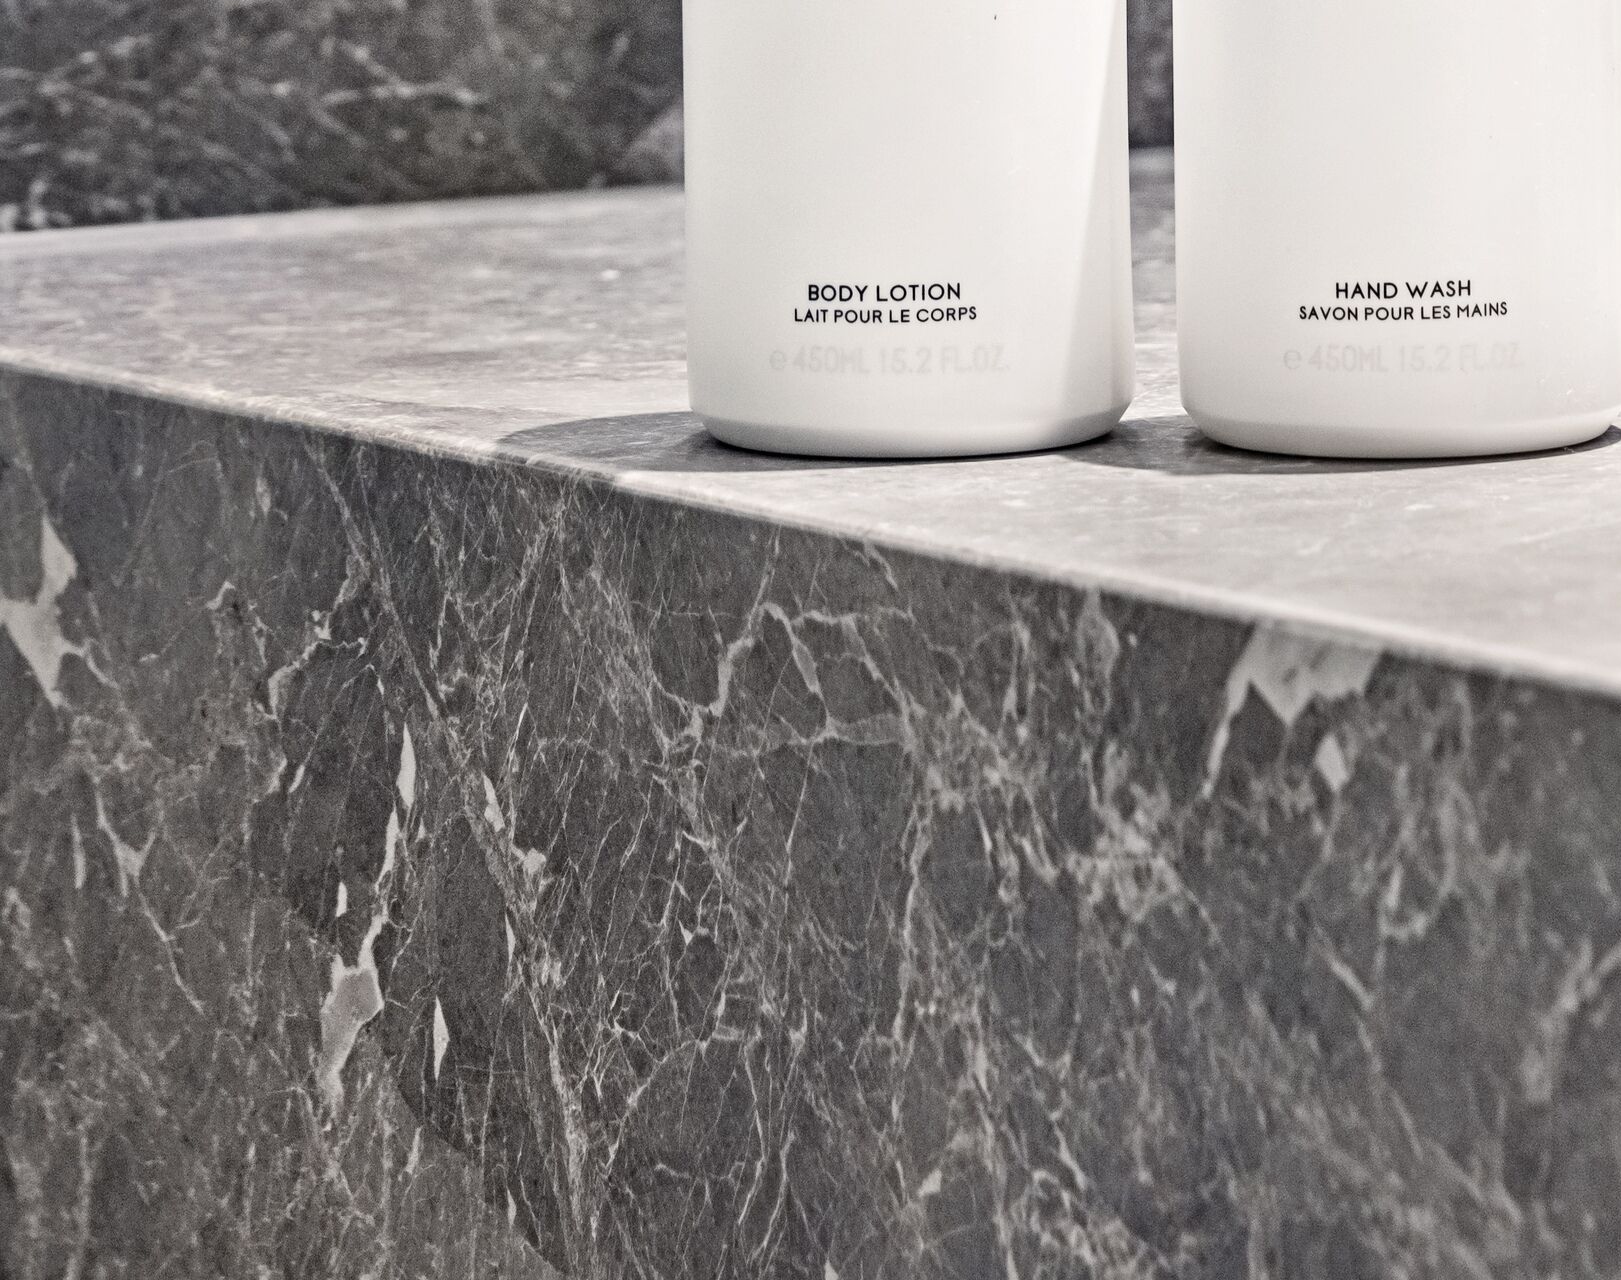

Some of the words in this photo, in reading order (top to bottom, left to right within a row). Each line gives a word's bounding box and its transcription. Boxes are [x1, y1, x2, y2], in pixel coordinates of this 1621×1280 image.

[808, 284, 868, 303] BODY
[876, 282, 961, 302] LOTION
[1335, 281, 1398, 300] HAND
[1405, 279, 1472, 298] WASH
[794, 308, 828, 323] LAIT
[834, 309, 882, 324] POUR
[889, 309, 910, 323] LE
[916, 306, 977, 323] CORPS
[1299, 305, 1359, 321] SAVON
[1364, 306, 1414, 321] POUR
[1420, 305, 1451, 320] LES
[1456, 301, 1508, 318] MAINS
[793, 344, 871, 375] 450ML
[879, 345, 933, 375] 15.2
[1308, 344, 1389, 373] 450ML
[1399, 344, 1451, 372] 15.2
